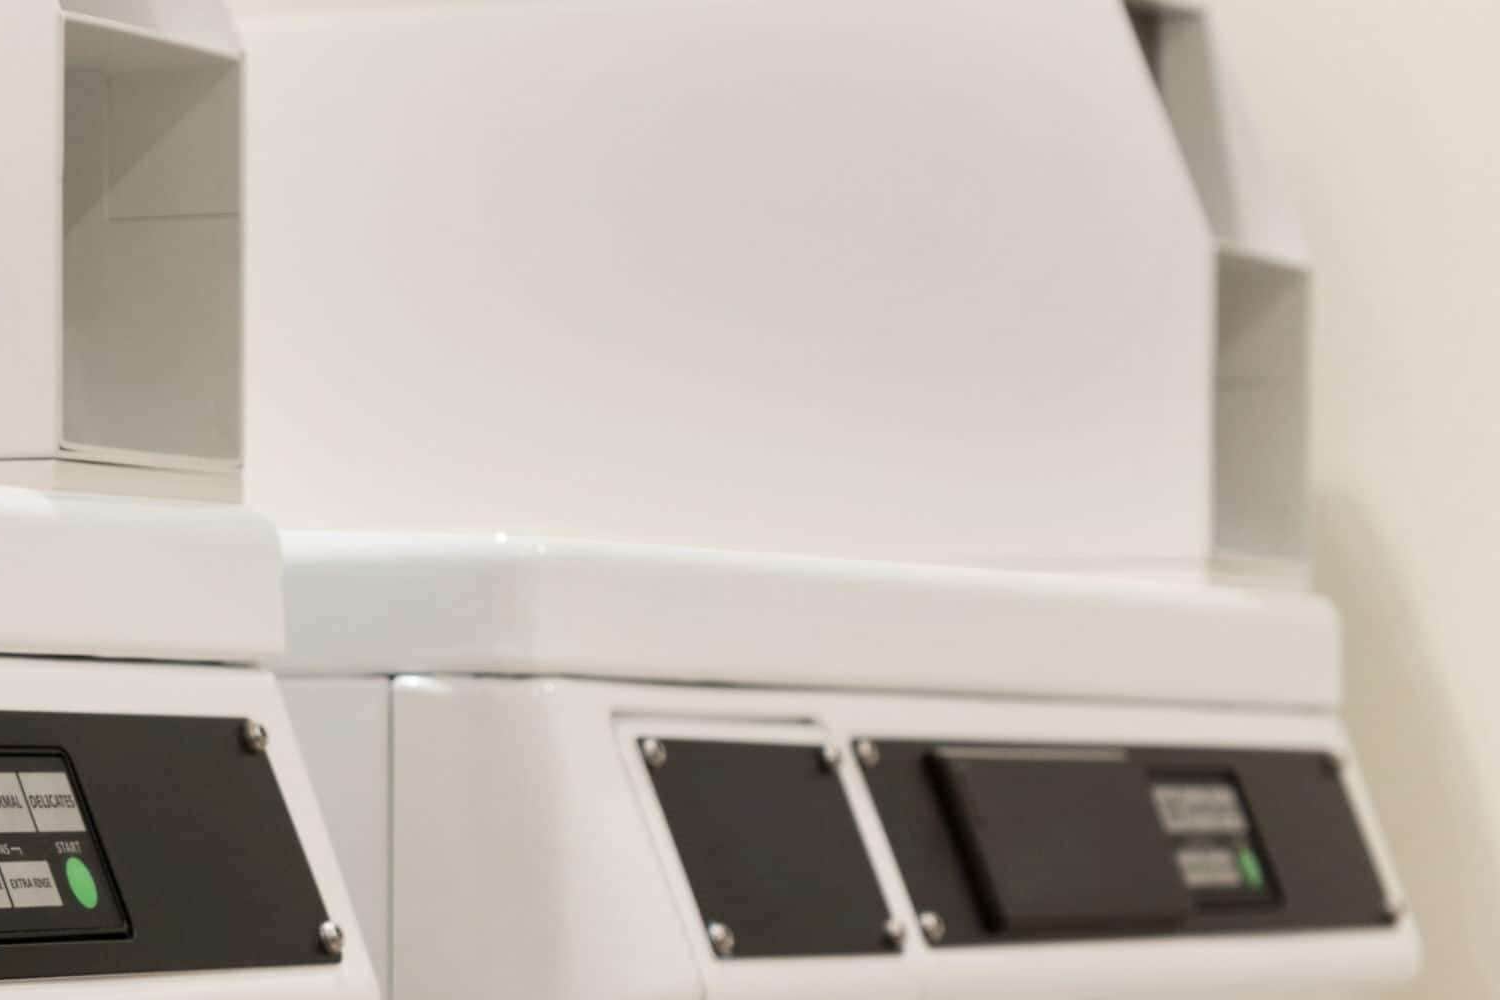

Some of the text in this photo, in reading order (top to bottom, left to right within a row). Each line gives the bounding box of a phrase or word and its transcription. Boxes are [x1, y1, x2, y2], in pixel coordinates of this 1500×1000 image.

[28, 795, 75, 809] DELICATES
[55, 841, 82, 854] START
[10, 878, 33, 889] EXTRA
